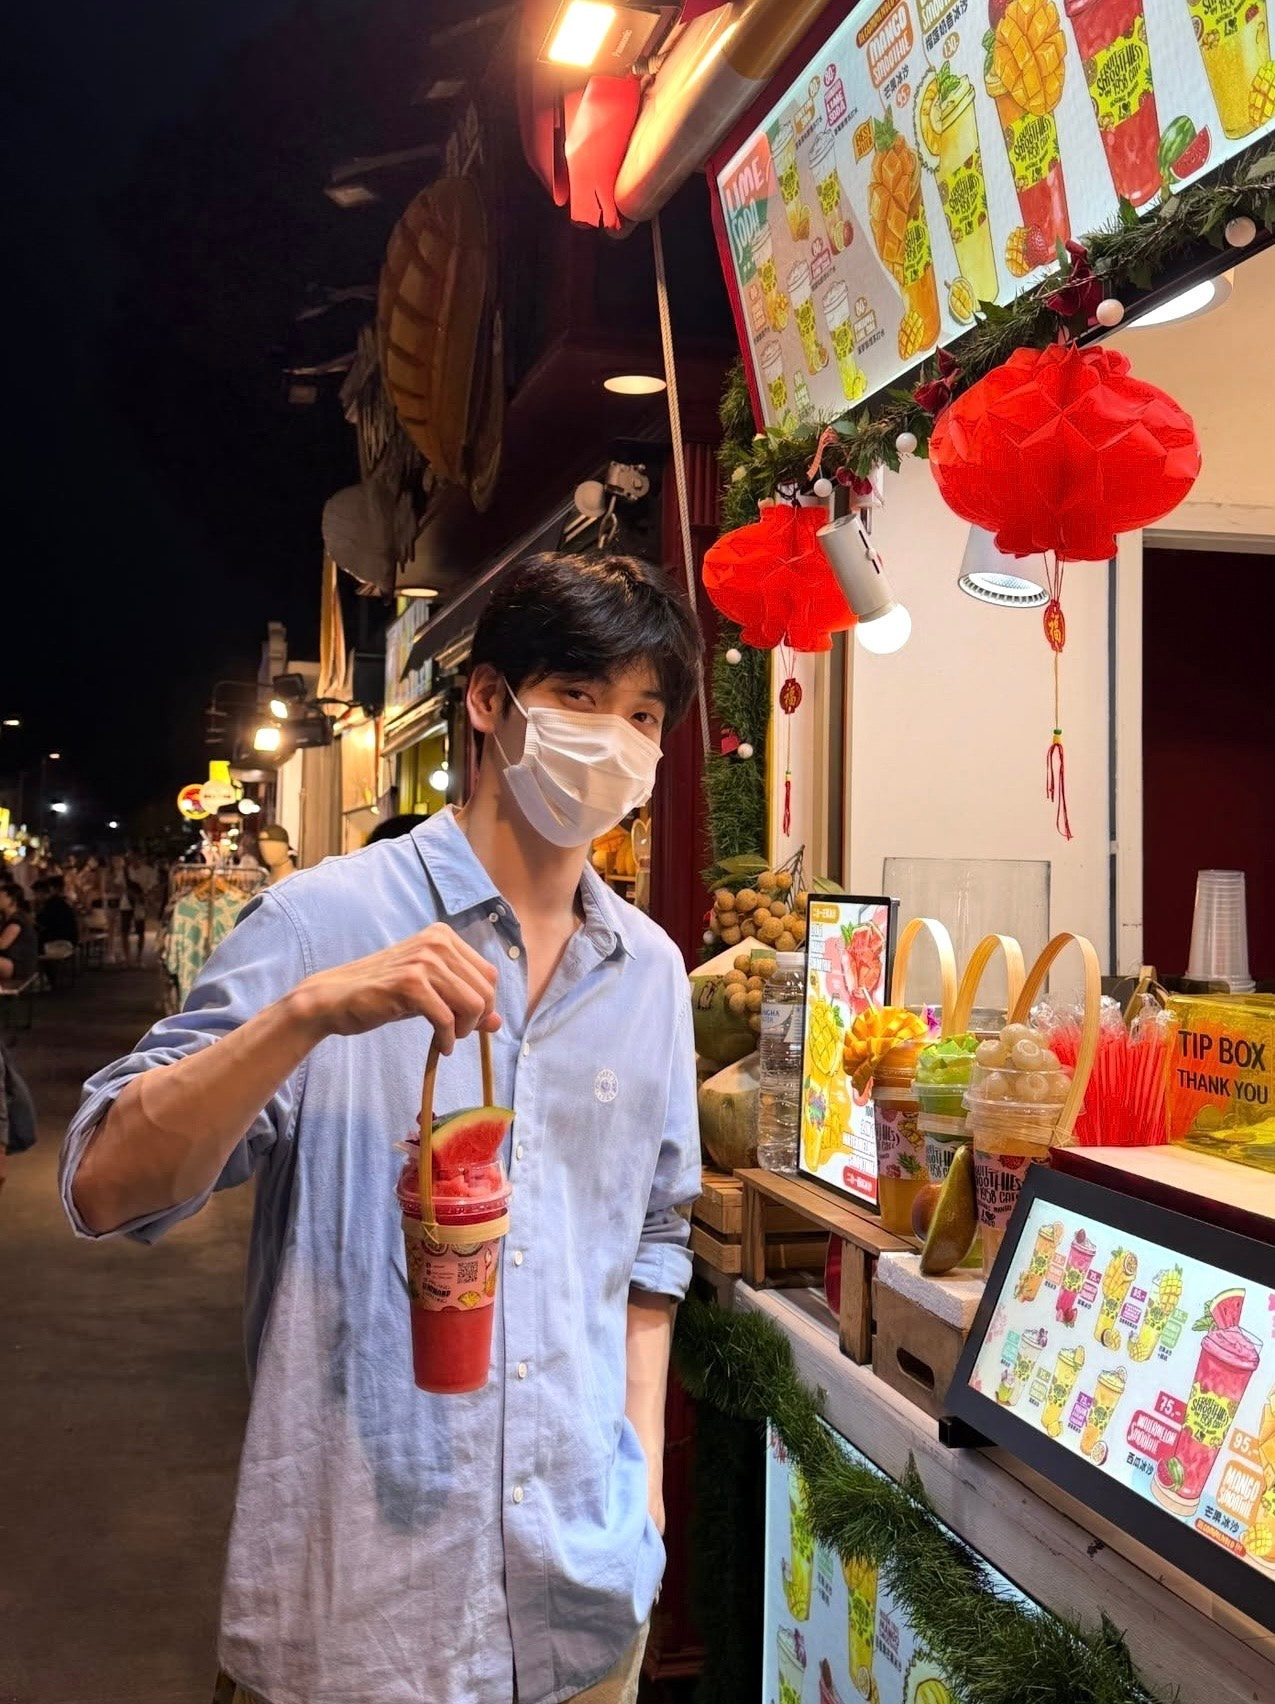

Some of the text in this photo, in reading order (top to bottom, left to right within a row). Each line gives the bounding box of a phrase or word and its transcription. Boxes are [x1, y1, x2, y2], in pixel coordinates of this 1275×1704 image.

[870, 5, 907, 67] MANGO
[725, 156, 764, 219] LIME
[1178, 1030, 1266, 1071] TIP BOX
[1177, 1068, 1269, 1105] THANK YOU
[993, 1204, 1012, 1214] MANGO
[1160, 1395, 1181, 1417] 75.-
[1233, 1432, 1259, 1457] 95.-
[1126, 1451, 1154, 1475] 西瓜冰沙
[1225, 1465, 1260, 1501] MANGO
